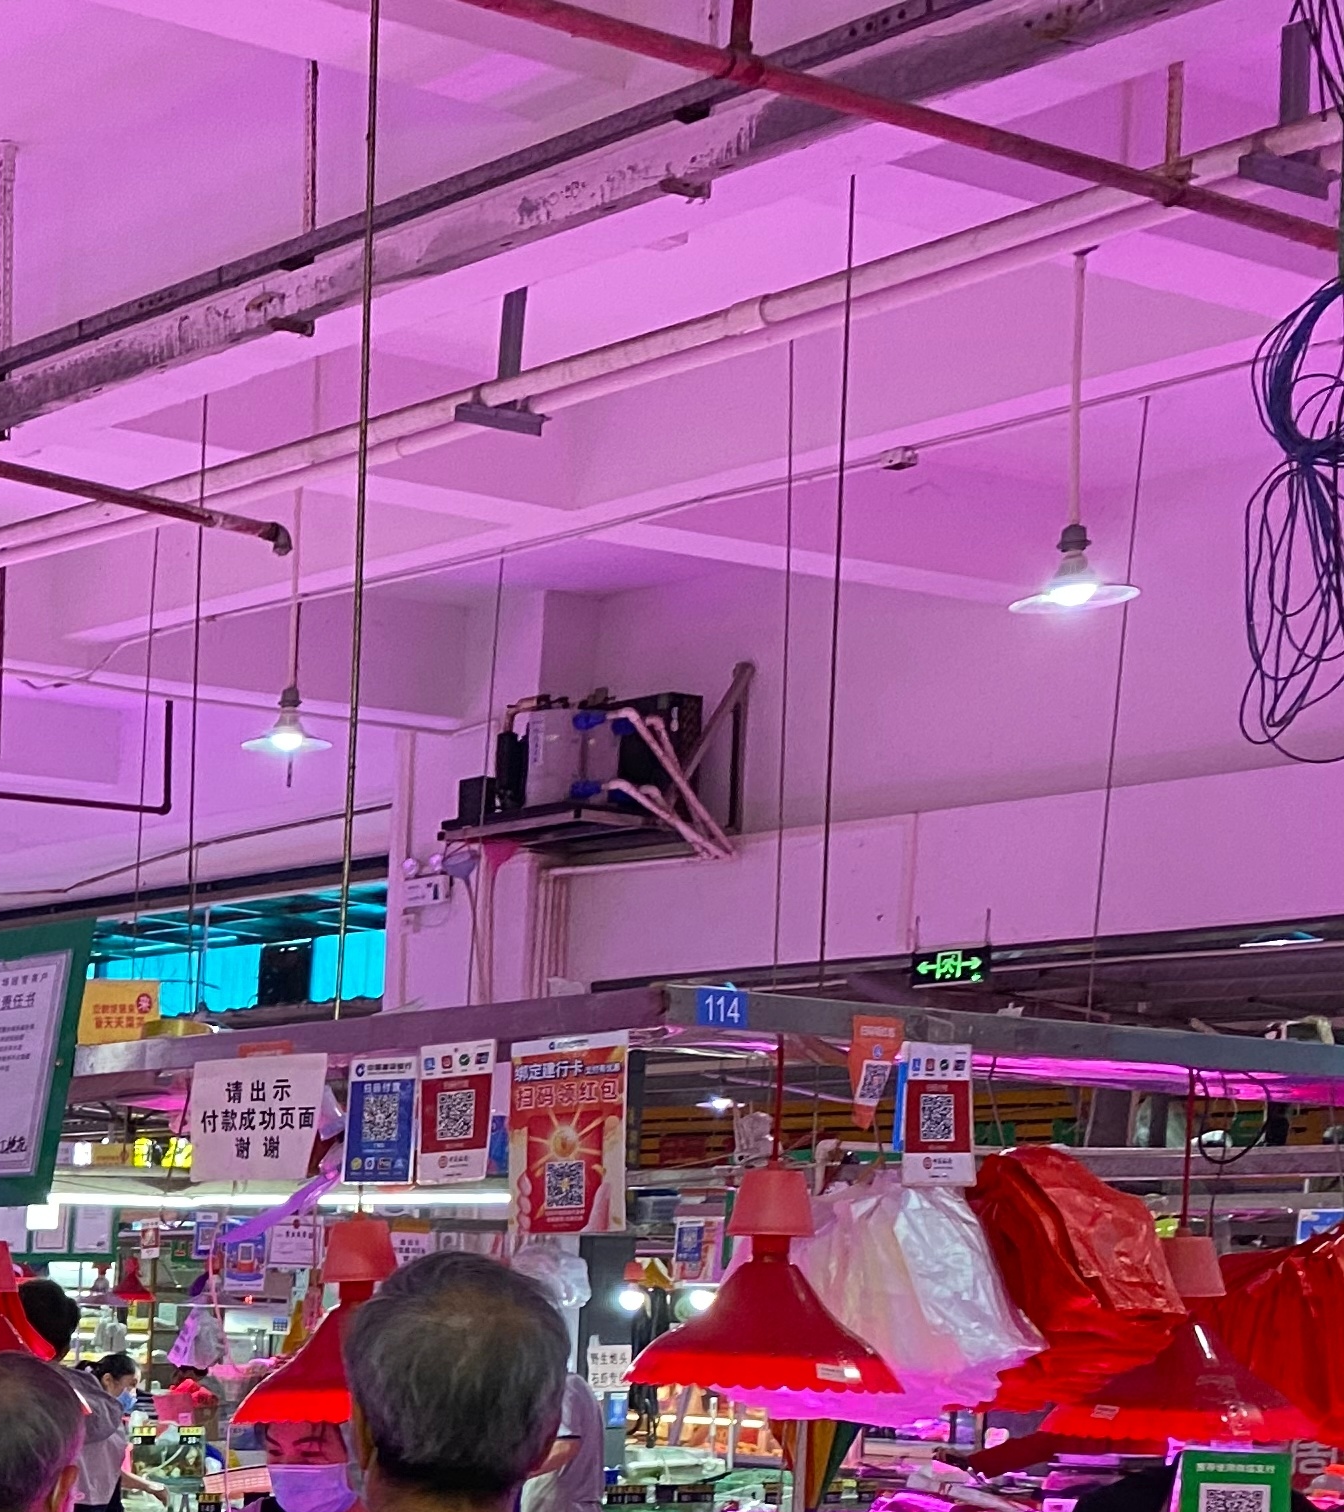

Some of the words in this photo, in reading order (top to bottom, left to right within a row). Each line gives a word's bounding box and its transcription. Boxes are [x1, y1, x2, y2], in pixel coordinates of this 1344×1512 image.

[705, 995, 740, 1023] 114
[225, 1079, 291, 1103] 请出示
[516, 1078, 619, 1111] 扫码领红包
[201, 1106, 316, 1133] 付款成功页面
[235, 1136, 280, 1159] 谢谢
